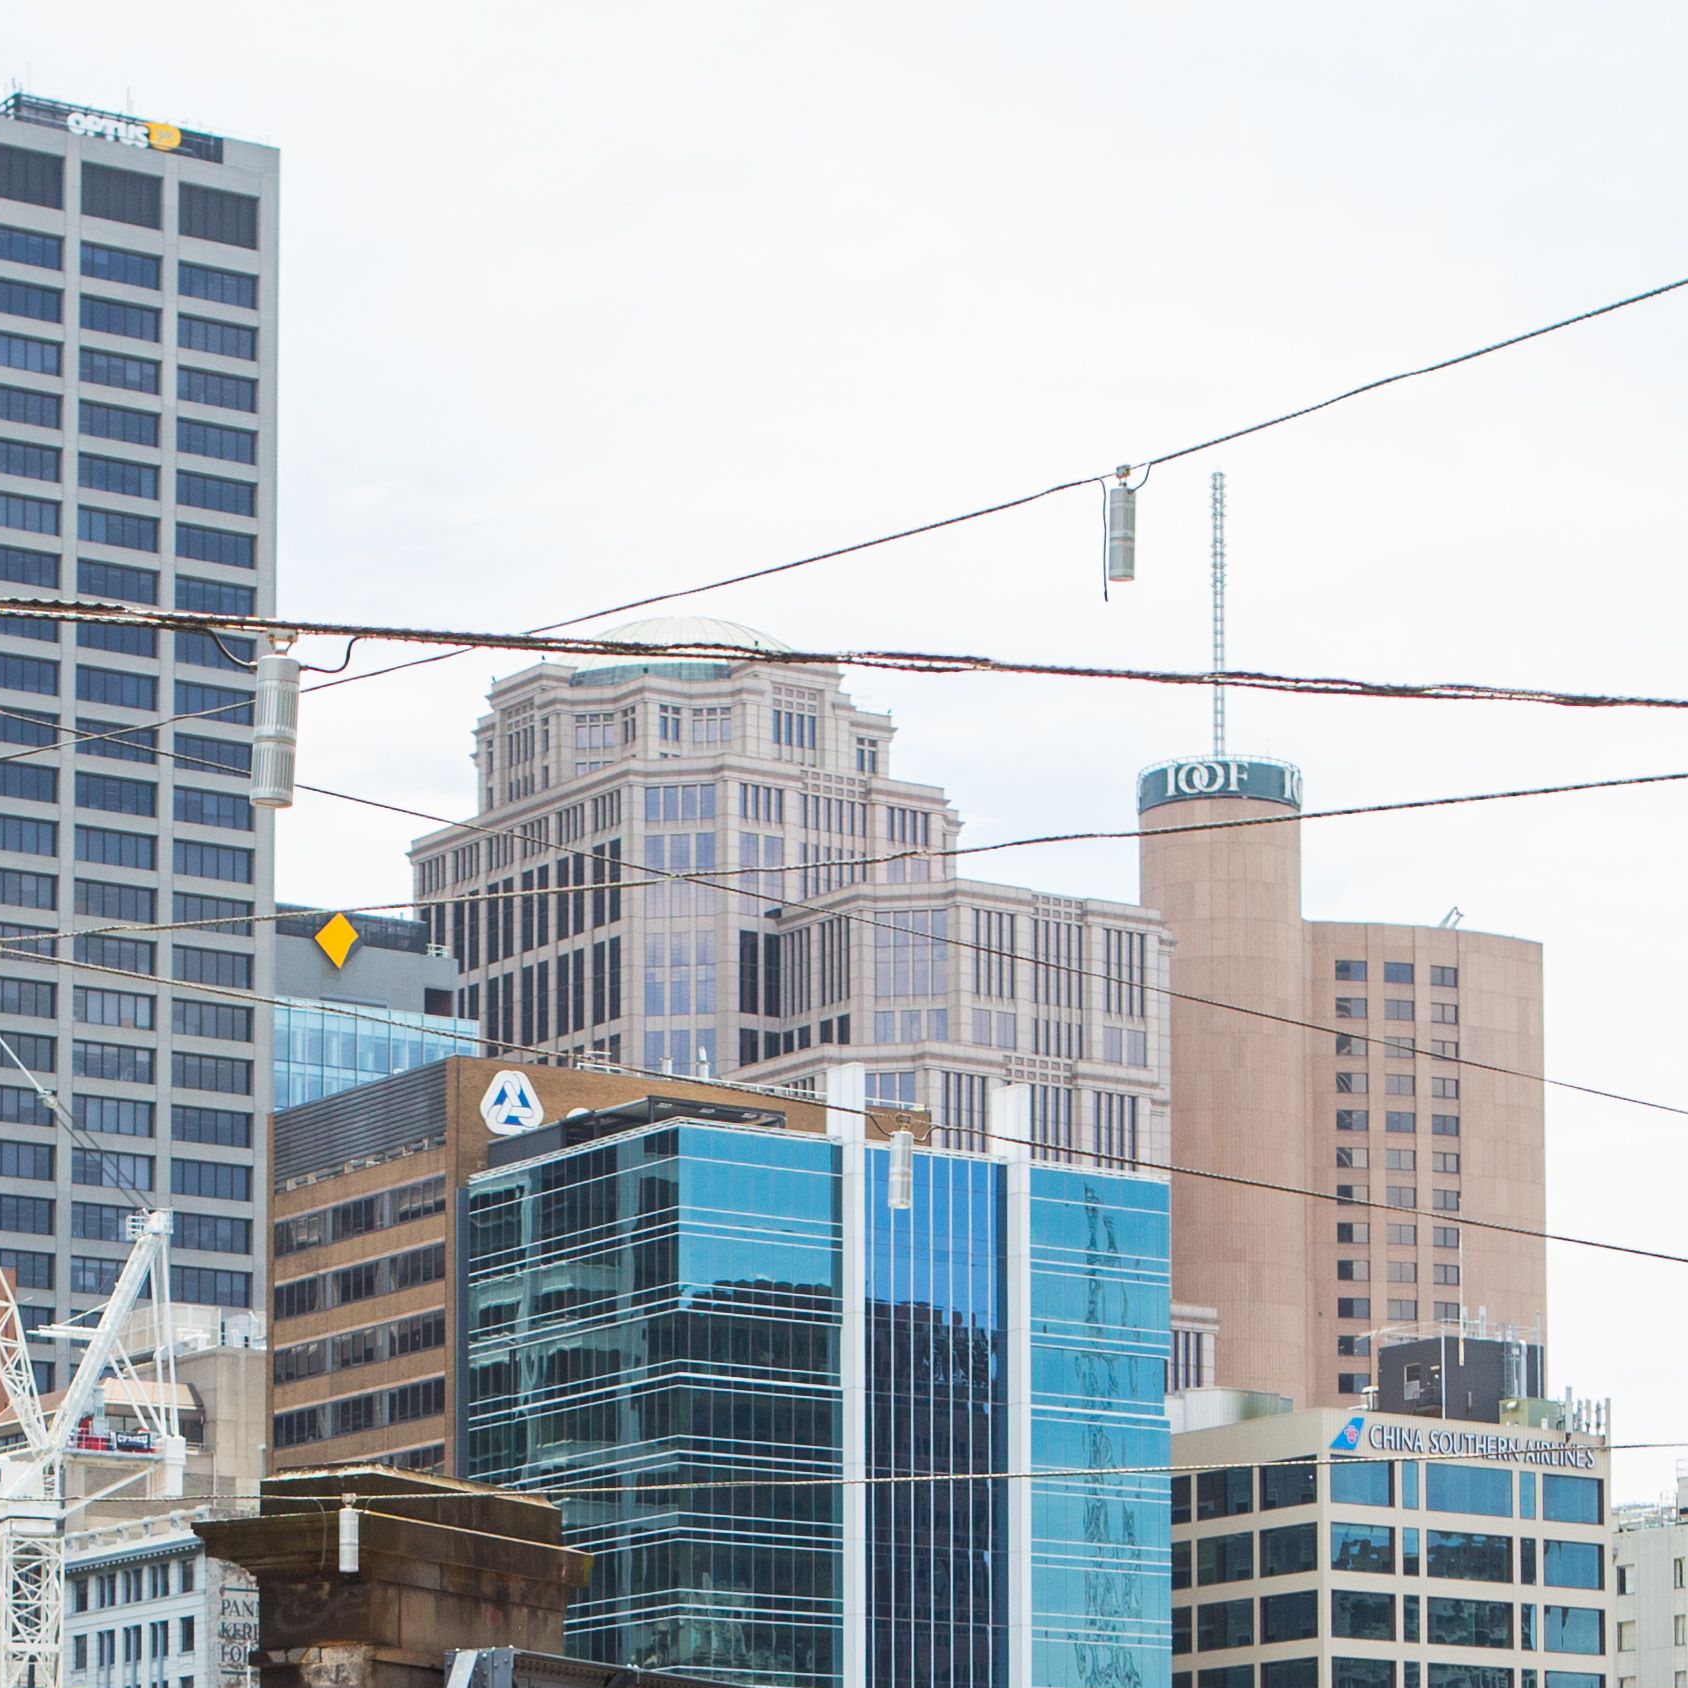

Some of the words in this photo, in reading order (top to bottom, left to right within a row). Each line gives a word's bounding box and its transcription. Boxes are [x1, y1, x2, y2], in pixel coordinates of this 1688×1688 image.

[67, 112, 150, 148] OPTUS
[1165, 761, 1250, 797] IOOF
[1369, 1424, 1424, 1453] CHINA
[1429, 1430, 1519, 1462] SOUTHERN
[1524, 1439, 1596, 1468] AIRLINES
